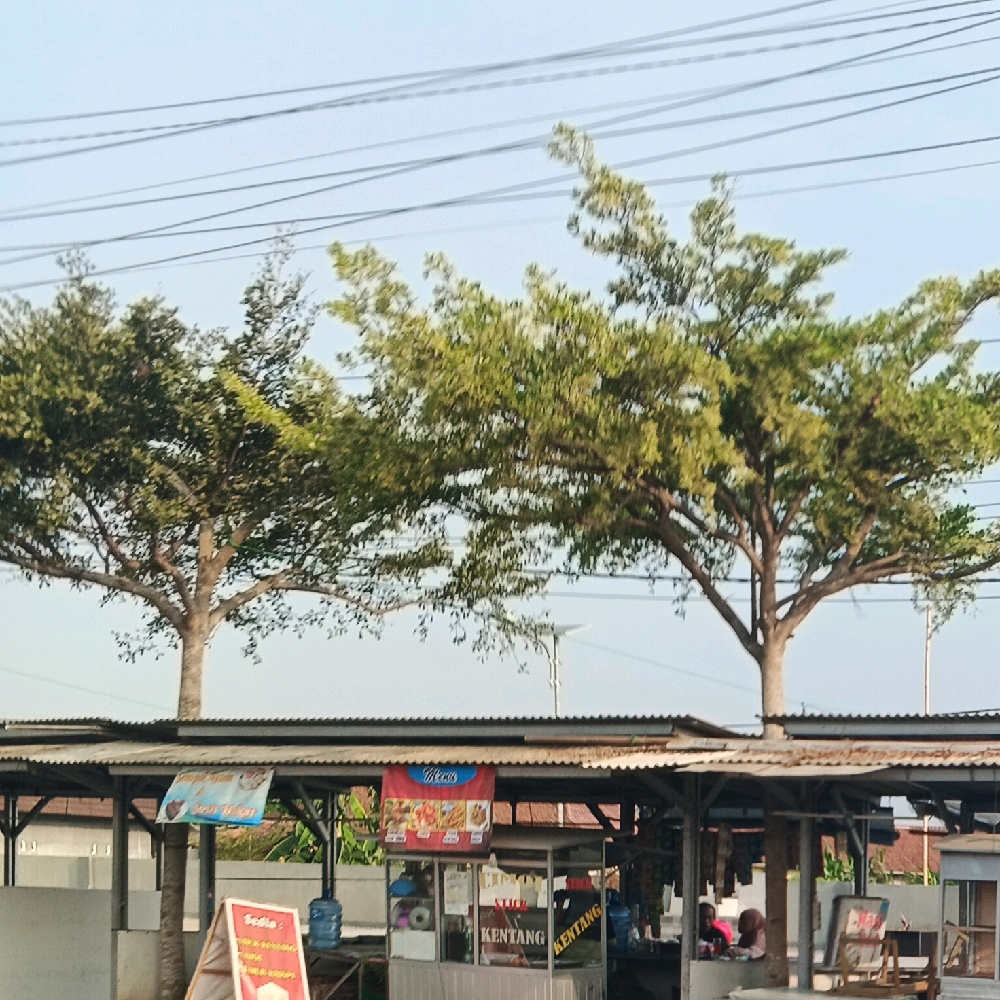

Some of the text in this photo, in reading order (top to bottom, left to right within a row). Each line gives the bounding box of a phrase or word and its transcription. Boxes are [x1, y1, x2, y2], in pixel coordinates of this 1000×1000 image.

[423, 767, 457, 784] Menu
[495, 898, 528, 912] STICK
[244, 913, 277, 930] Sedia
[553, 903, 602, 956] KENTANG
[481, 926, 545, 946] KENTANG
